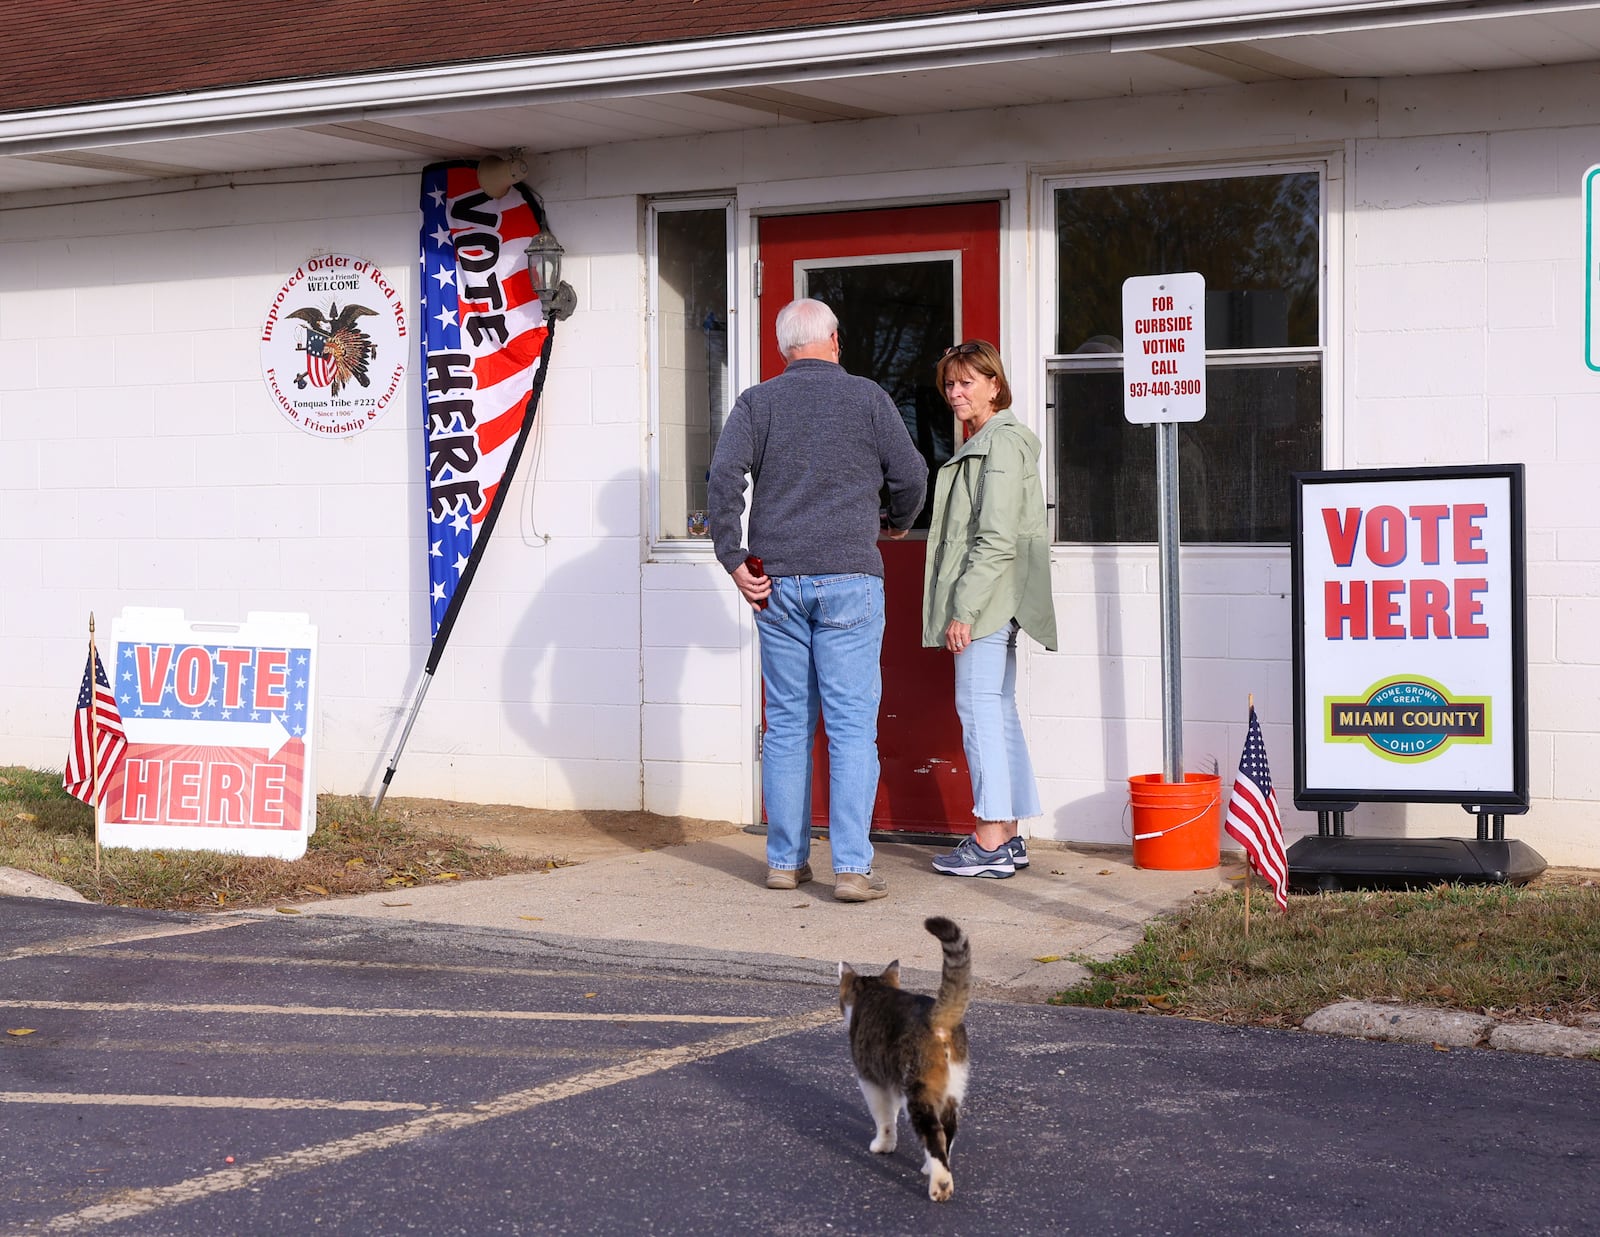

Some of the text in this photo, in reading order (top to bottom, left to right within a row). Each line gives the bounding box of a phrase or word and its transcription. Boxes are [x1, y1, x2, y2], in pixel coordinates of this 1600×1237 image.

[307, 280, 360, 291] WELCOME
[335, 273, 360, 281] Friendly
[262, 255, 407, 342] Improved Order of Red Men
[1152, 296, 1174, 312] FOR
[1135, 316, 1193, 334] CURBSIDE
[427, 191, 510, 520] VOTE HERE
[1142, 338, 1185, 355] VOTING
[1151, 359, 1178, 375] CALL
[1129, 379, 1201, 398] 937-440-3900
[266, 363, 405, 433] Freedom, Friendship & Charity
[293, 398, 376, 409] Tonquas Tribe #222
[1321, 503, 1488, 568] VOTE
[1324, 577, 1489, 641] HERE
[135, 644, 289, 711] VOTE
[1375, 686, 1438, 704] HOME. GROWN.
[1392, 695, 1422, 703] GREAT.
[1339, 711, 1479, 726] MIAMI COUNTY
[122, 758, 287, 827] HERE
